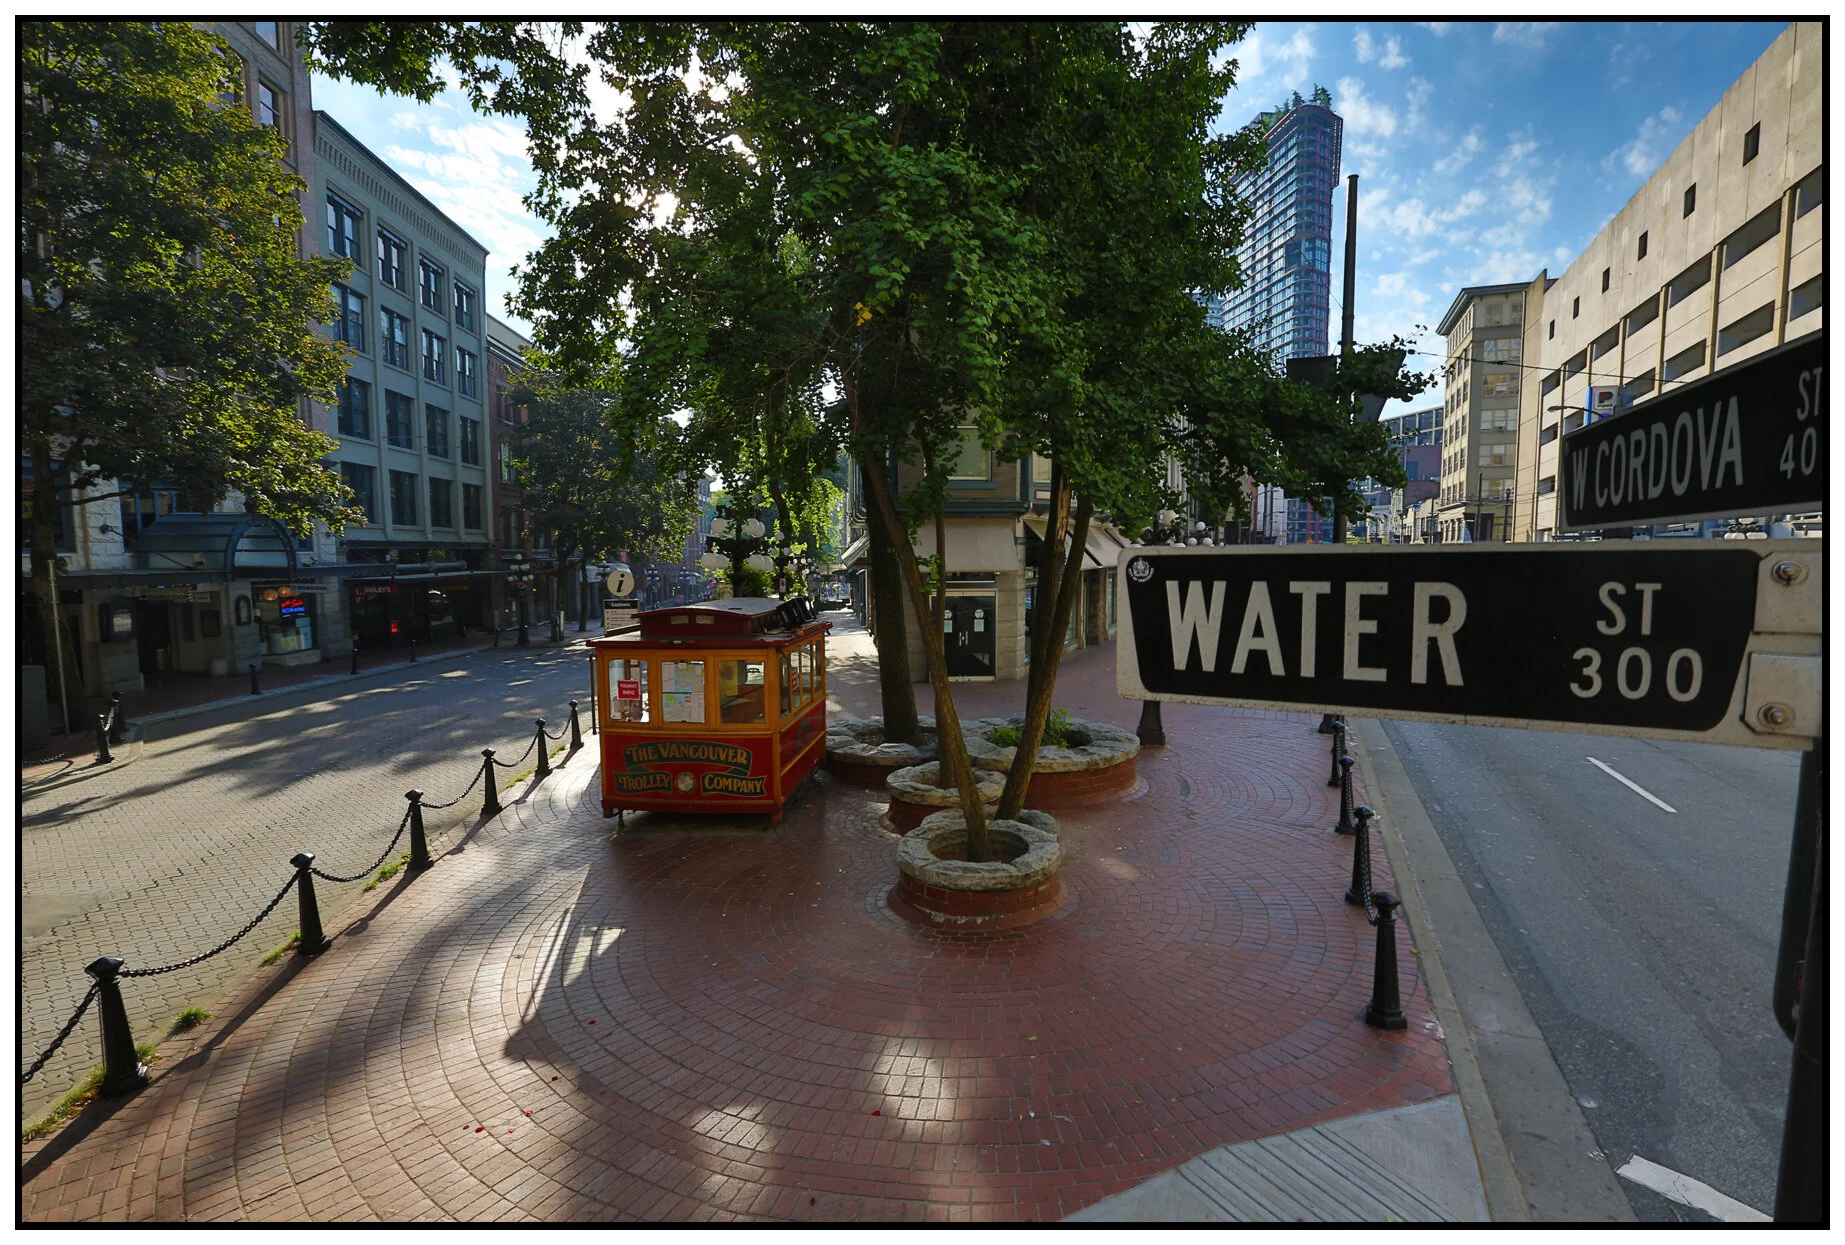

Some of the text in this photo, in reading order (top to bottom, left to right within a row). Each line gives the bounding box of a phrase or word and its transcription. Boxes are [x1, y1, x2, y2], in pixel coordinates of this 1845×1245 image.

[1797, 366, 1822, 421] ST
[1573, 395, 1744, 511] W CORDOVA
[1165, 580, 1662, 686] WATER ST
[1569, 646, 1703, 702] 300
[626, 742, 748, 765] THE VANCOUVER
[618, 773, 765, 793] TROLLEY COMPANY
